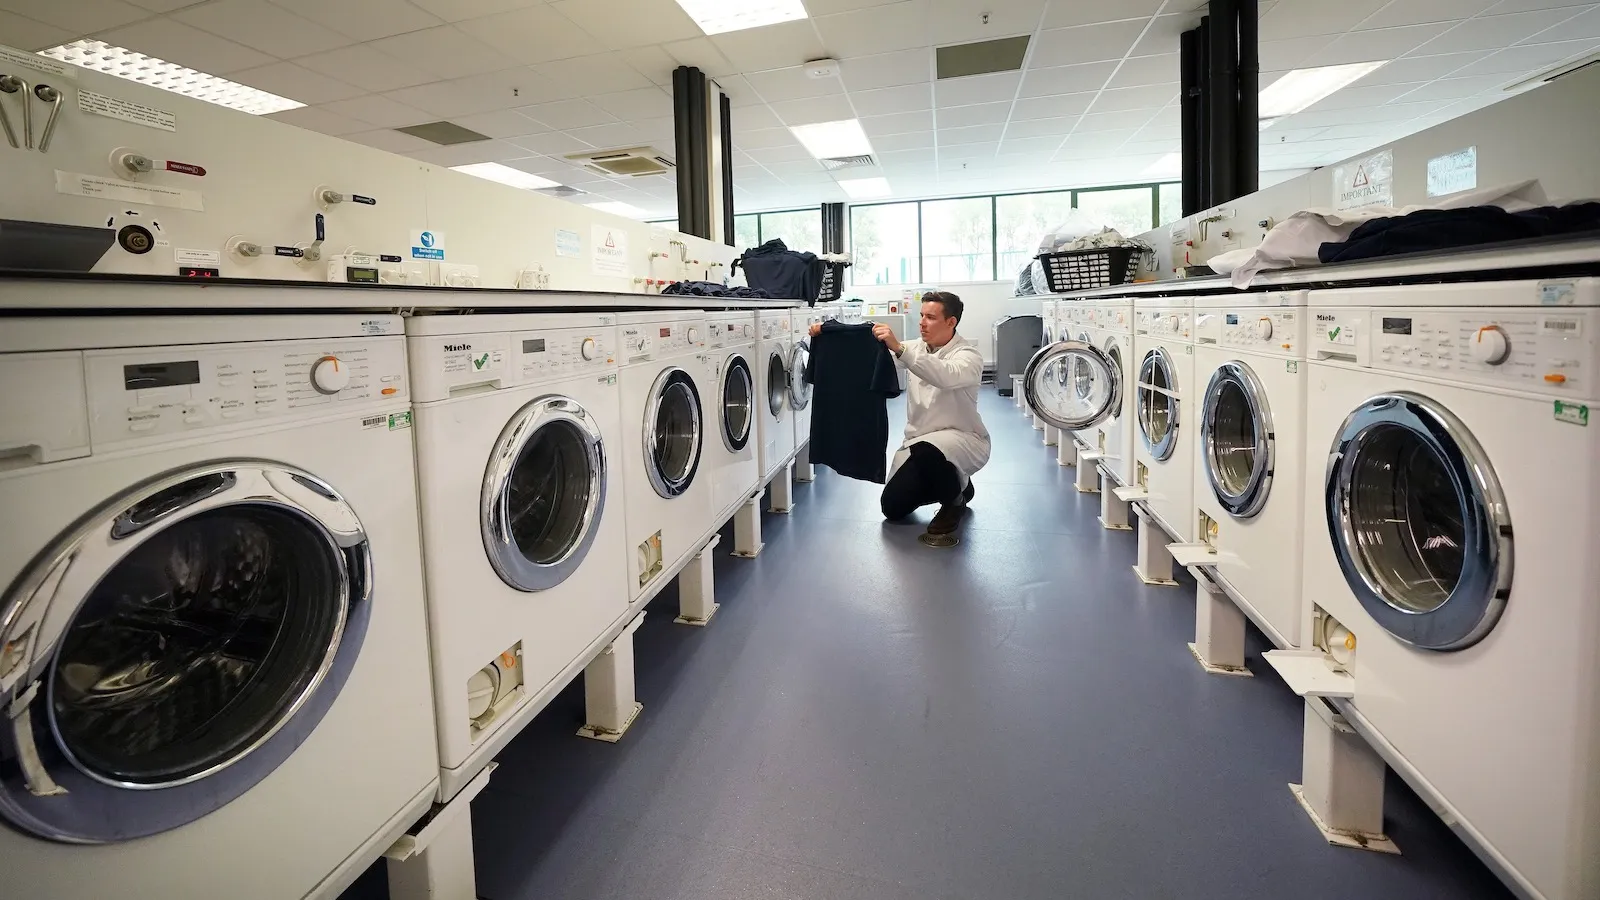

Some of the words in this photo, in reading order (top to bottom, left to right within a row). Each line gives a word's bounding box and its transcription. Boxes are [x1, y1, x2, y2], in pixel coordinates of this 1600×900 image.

[1341, 184, 1383, 202] IMPORTANT
[1317, 314, 1336, 322] Miele
[444, 343, 472, 352] Miele
